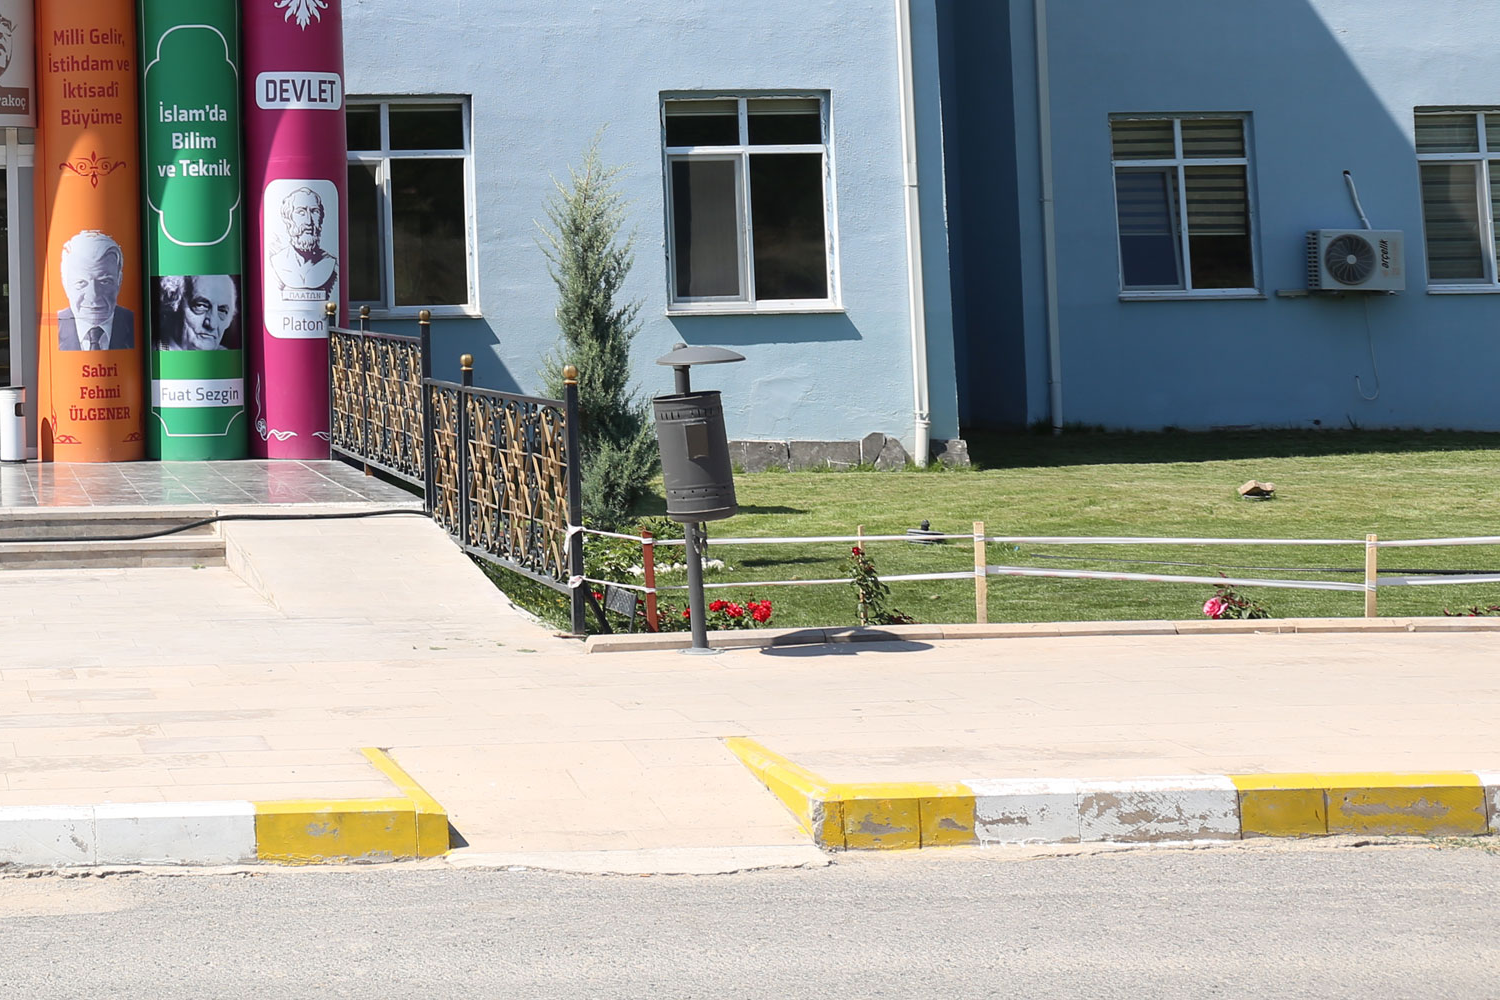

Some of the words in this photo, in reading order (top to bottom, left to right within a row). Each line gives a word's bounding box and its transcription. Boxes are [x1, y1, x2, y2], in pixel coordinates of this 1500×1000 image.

[53, 28, 85, 47] Milli
[90, 28, 125, 50] Gelir,
[48, 53, 112, 73] İstihdam
[116, 58, 130, 73] ve
[63, 79, 120, 99] İktisadî
[265, 79, 337, 103] DEVLET
[61, 107, 122, 130] Büyüme
[171, 131, 217, 151] Bilim
[157, 164, 176, 178] ve
[179, 159, 232, 178] Teknik
[282, 316, 324, 331] Platon
[82, 363, 118, 378] Sabri
[80, 385, 120, 399] Fehmi
[161, 386, 192, 402] Fuat
[196, 386, 239, 404] Sezgin
[69, 403, 131, 422] ÜLGENER
